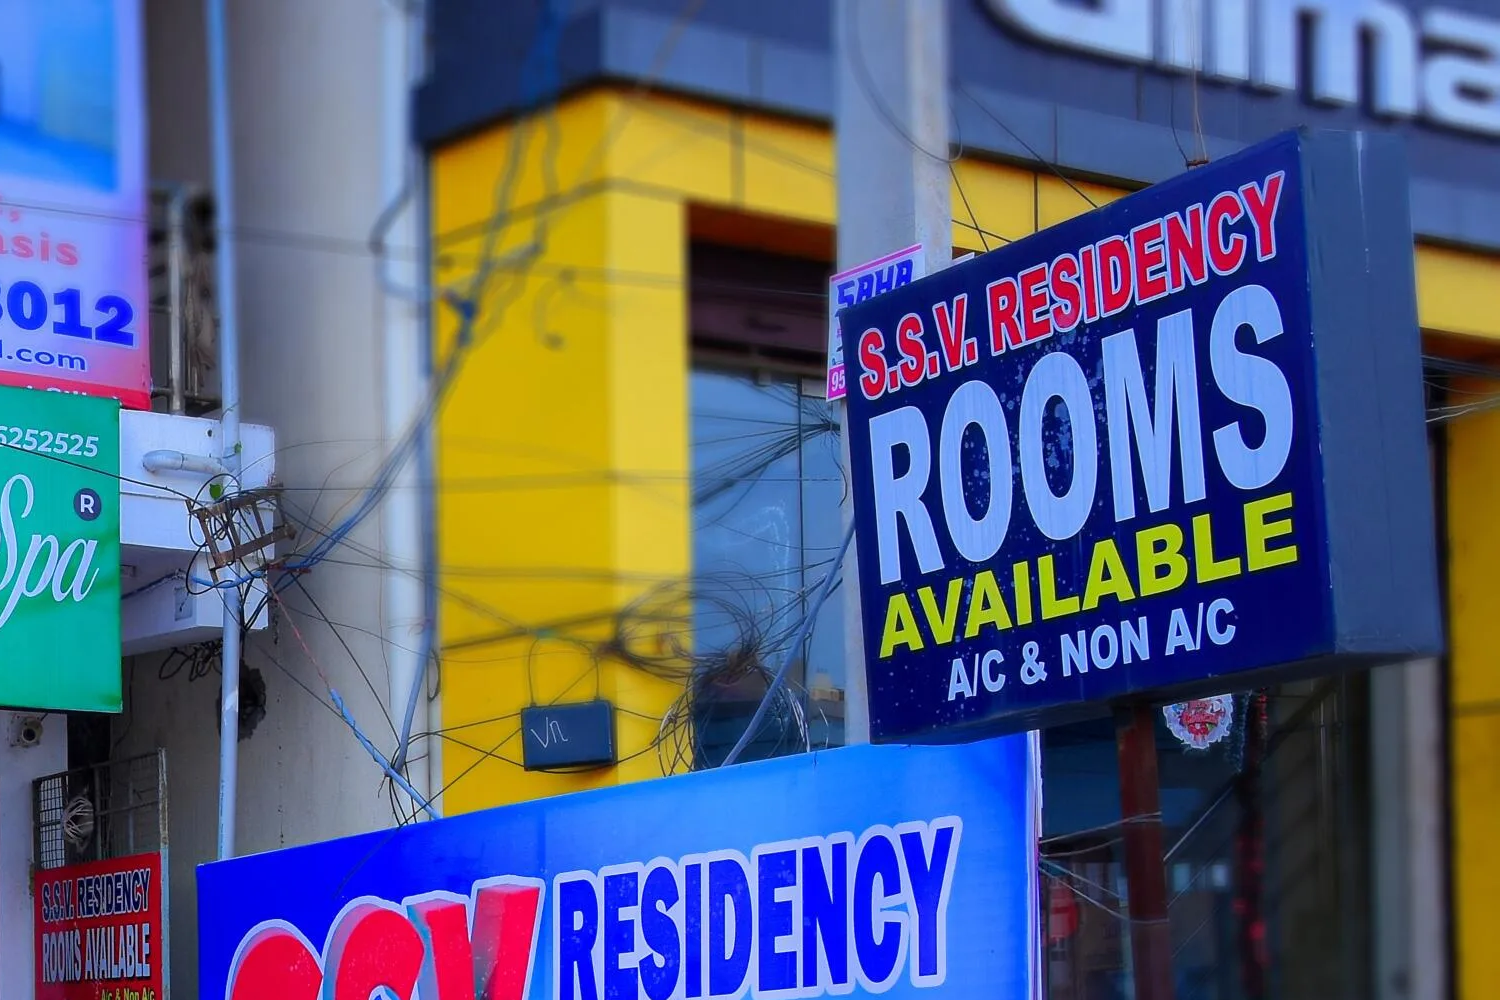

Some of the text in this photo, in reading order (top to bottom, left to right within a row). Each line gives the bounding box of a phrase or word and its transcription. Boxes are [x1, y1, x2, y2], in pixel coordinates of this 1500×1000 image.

[858, 170, 1285, 401] S.S.V. RESIDENCY
[869, 284, 1294, 584] ROOMS
[879, 492, 1298, 659] AVAILABLE
[947, 597, 1237, 701] A/C & NON A/C
[42, 923, 151, 983] ROOMS AVAILABLE
[77, 868, 151, 918] RESIDENCY
